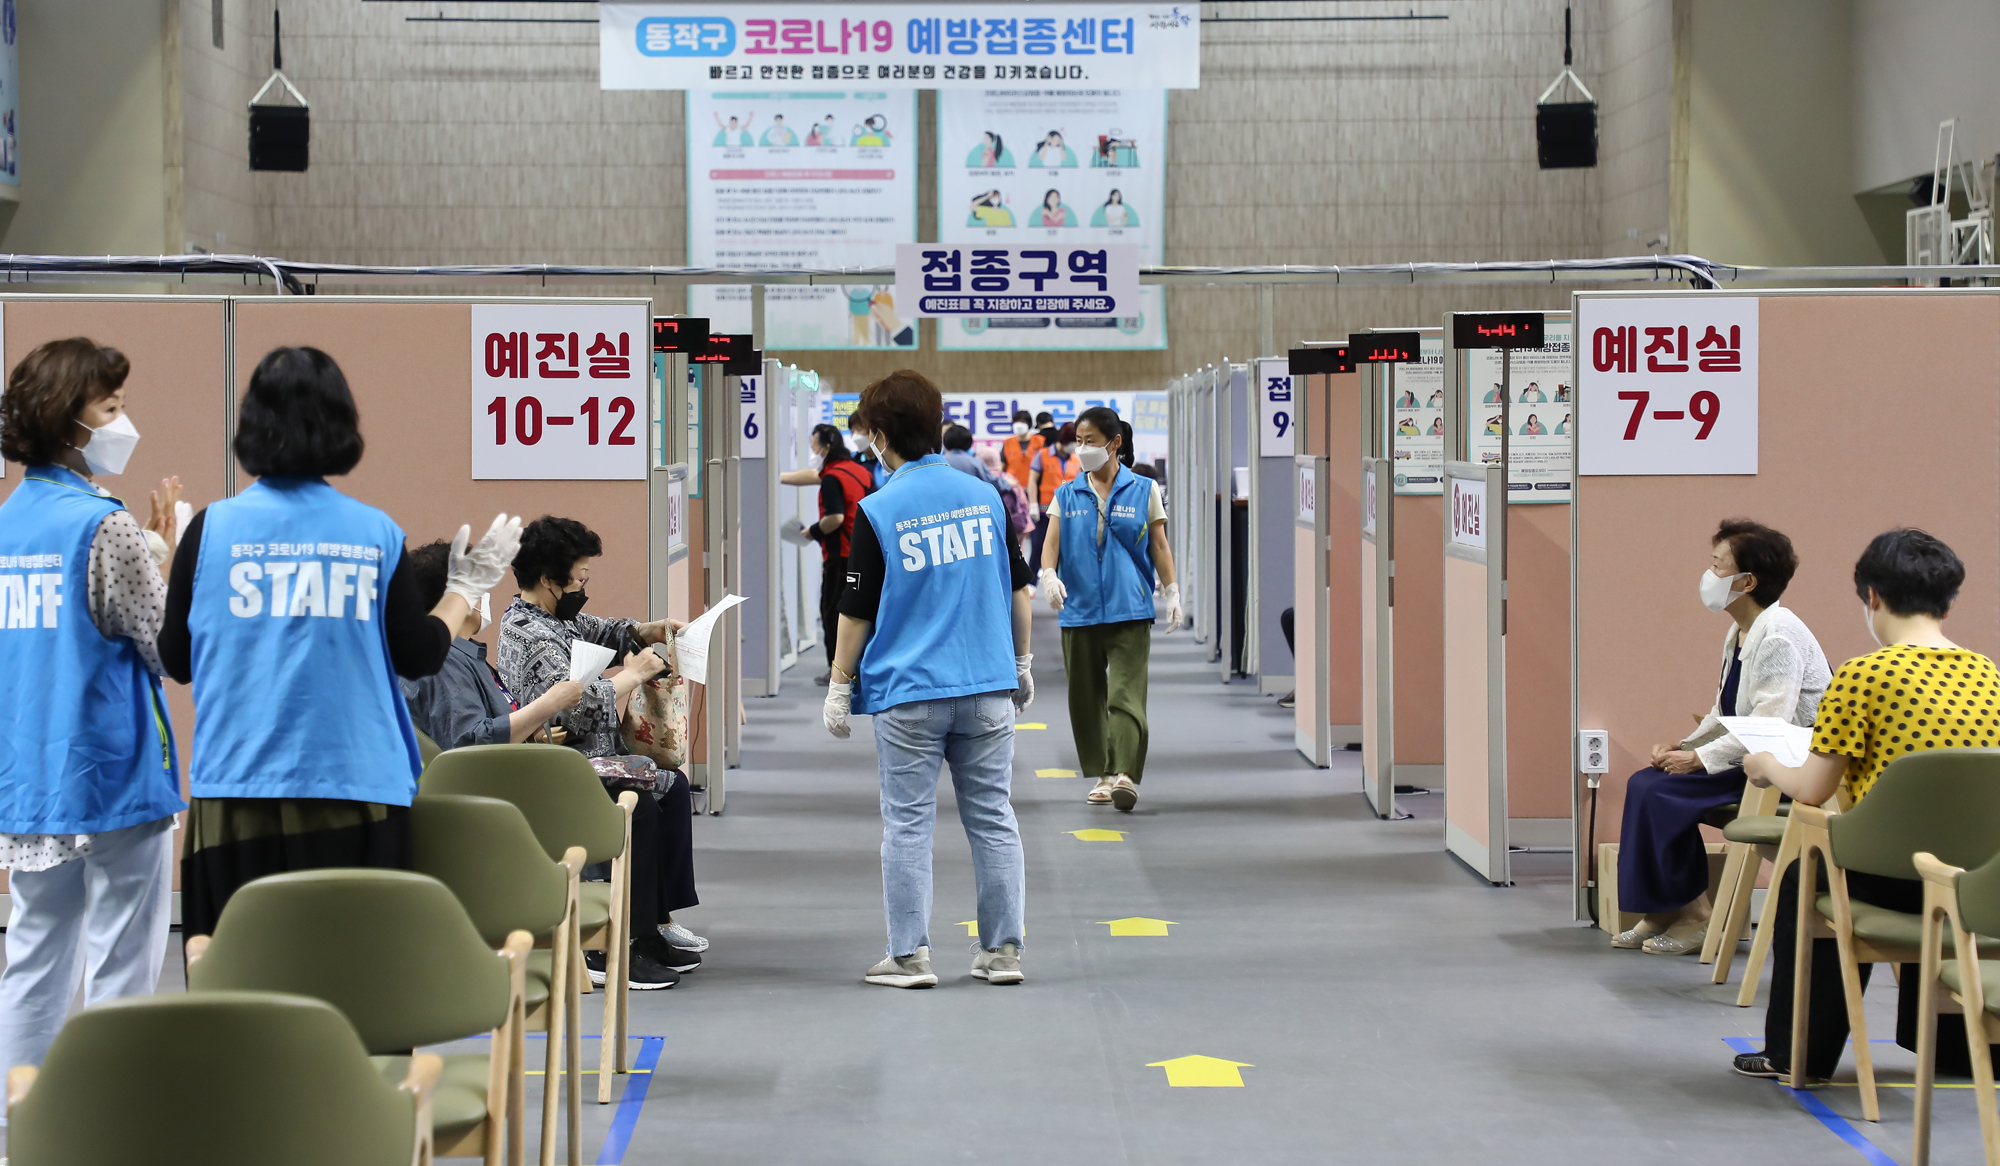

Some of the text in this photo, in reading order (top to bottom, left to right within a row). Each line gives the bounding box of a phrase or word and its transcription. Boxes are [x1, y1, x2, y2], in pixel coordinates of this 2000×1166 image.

[645, 17, 1135, 55] 동작구 코로나19 예방접종센터
[708, 64, 1090, 80] 빠르고 안전한 접종으로 여러분의 건강을 지키겠습니다.
[921, 249, 1108, 292] 접종구역
[925, 298, 1110, 311] 예진표를 꼭 지참하고 입장해 주세요.
[484, 331, 631, 379] 예진실
[1592, 324, 1742, 373] 예진실
[1267, 376, 1291, 402] 접
[487, 395, 636, 446] 10-12
[1273, 411, 1294, 438] 9
[1617, 389, 1721, 440] 7-9
[895, 504, 991, 532] 동작구 코로나19 예방접종센터
[1462, 493, 1480, 536] 예진실
[230, 544, 265, 558] 동작구
[268, 543, 314, 557] 코로나19
[899, 517, 994, 572] STAFF
[228, 561, 379, 622] STAFF
